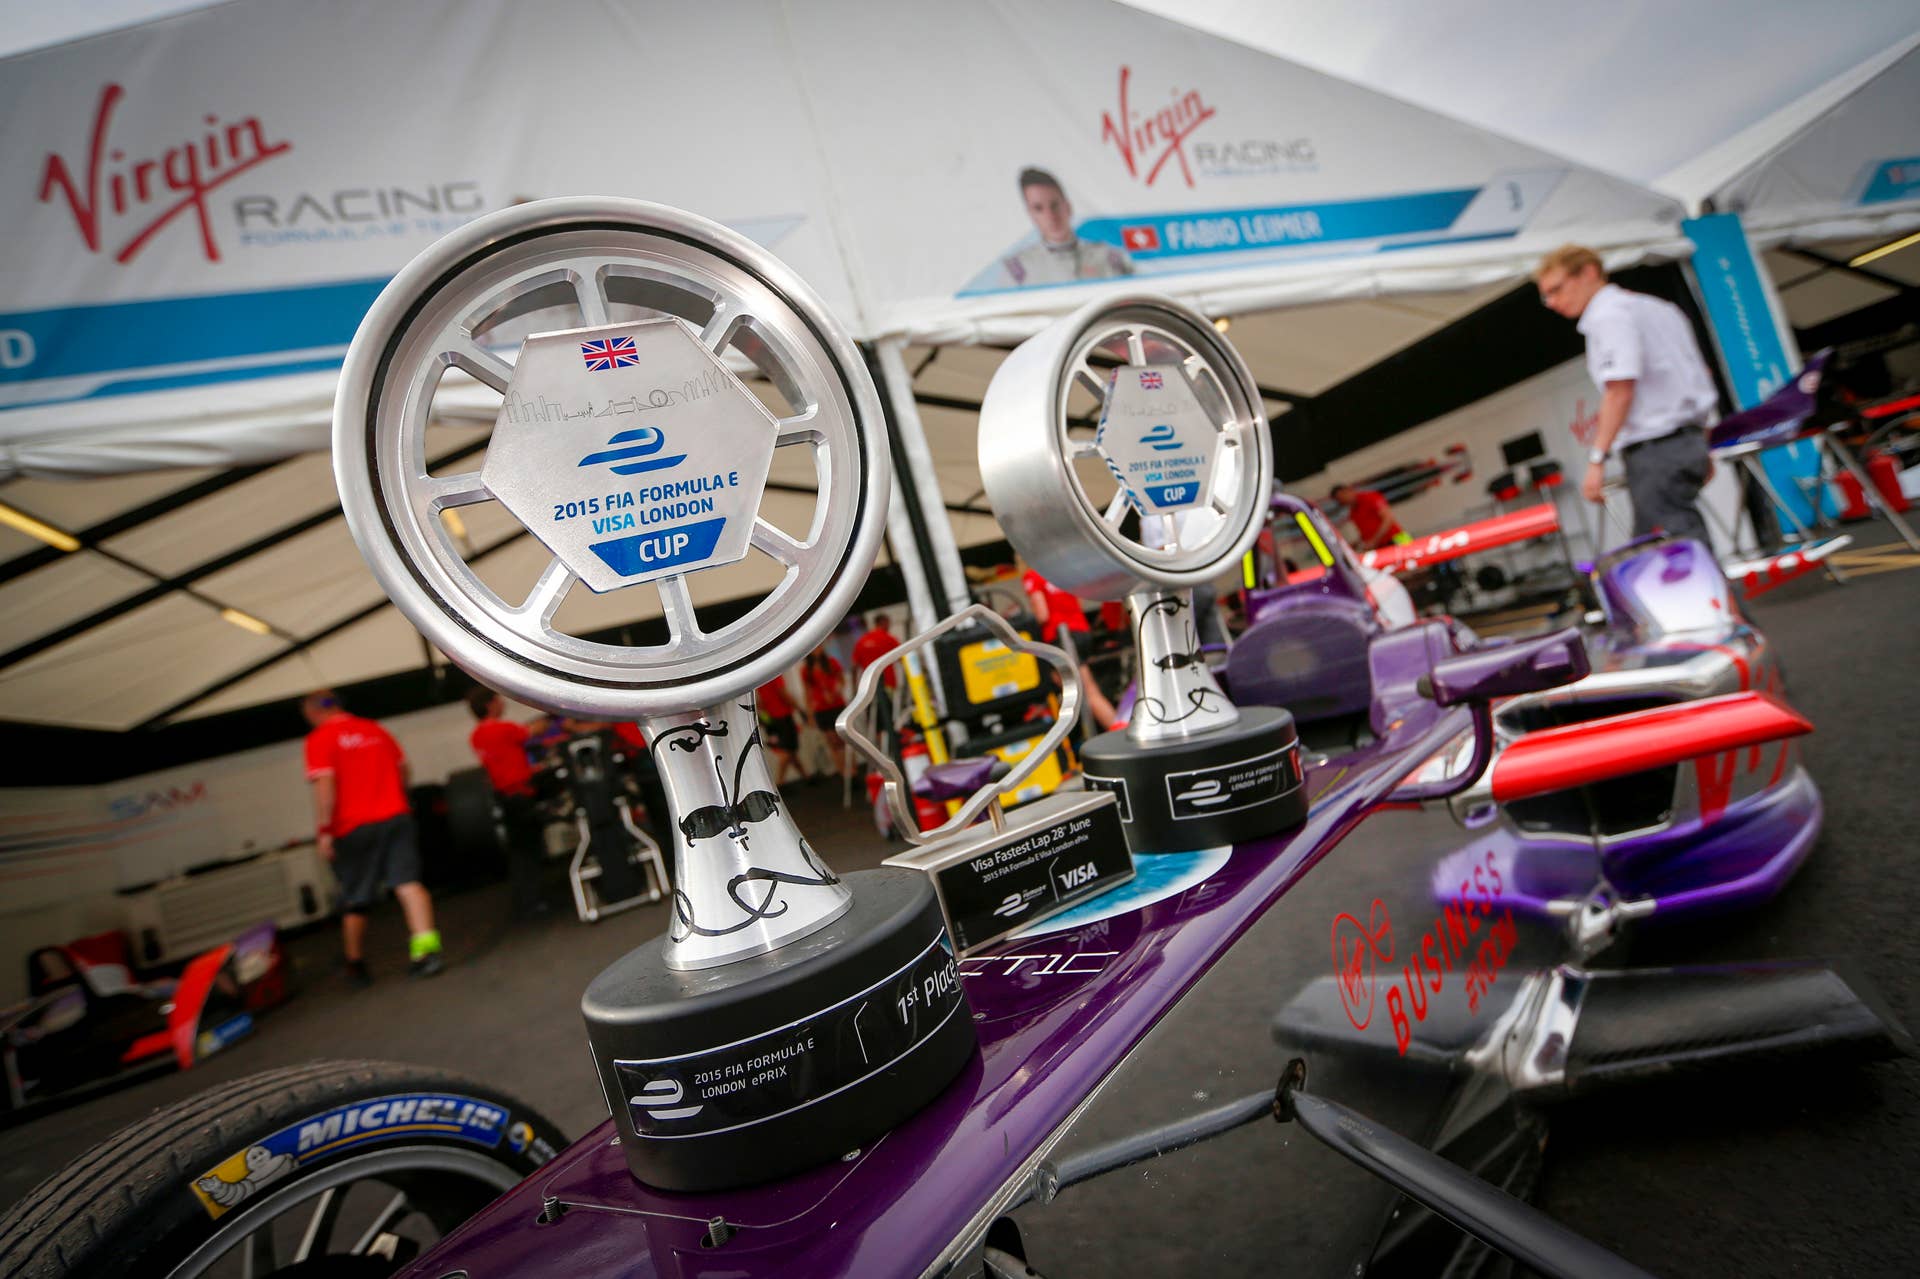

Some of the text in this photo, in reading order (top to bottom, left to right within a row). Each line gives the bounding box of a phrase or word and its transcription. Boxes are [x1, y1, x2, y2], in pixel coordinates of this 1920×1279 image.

[1102, 65, 1216, 188] Virgin
[40, 83, 291, 263] Virgin
[1193, 138, 1317, 166] RACING
[233, 181, 484, 228] RACING
[1165, 211, 1323, 250] FABIO LEIMER
[553, 471, 739, 521] 2015 FIA FORMULA E
[1146, 470, 1195, 482] VISA LONDON
[1164, 487, 1185, 502] CUP
[592, 497, 714, 535] VISA LONDON
[639, 533, 689, 563] CUP
[971, 857, 994, 873] Visa
[994, 842, 1031, 865] Fastest
[1031, 834, 1050, 851] Lap
[1069, 818, 1091, 834] June
[982, 870, 999, 883] 2015
[999, 865, 1010, 877] FIA
[1010, 857, 1035, 872] Formula
[1051, 841, 1075, 855] London
[1058, 861, 1099, 890] VISA
[1386, 850, 1503, 1057] BUSINESS
[897, 986, 919, 1025] 1st
[923, 958, 956, 1007] Place
[694, 1037, 815, 1085] 2015 FIA FORMULA E
[701, 1064, 788, 1099] LONDON ePRIX
[298, 1098, 501, 1150] MICHELIN
